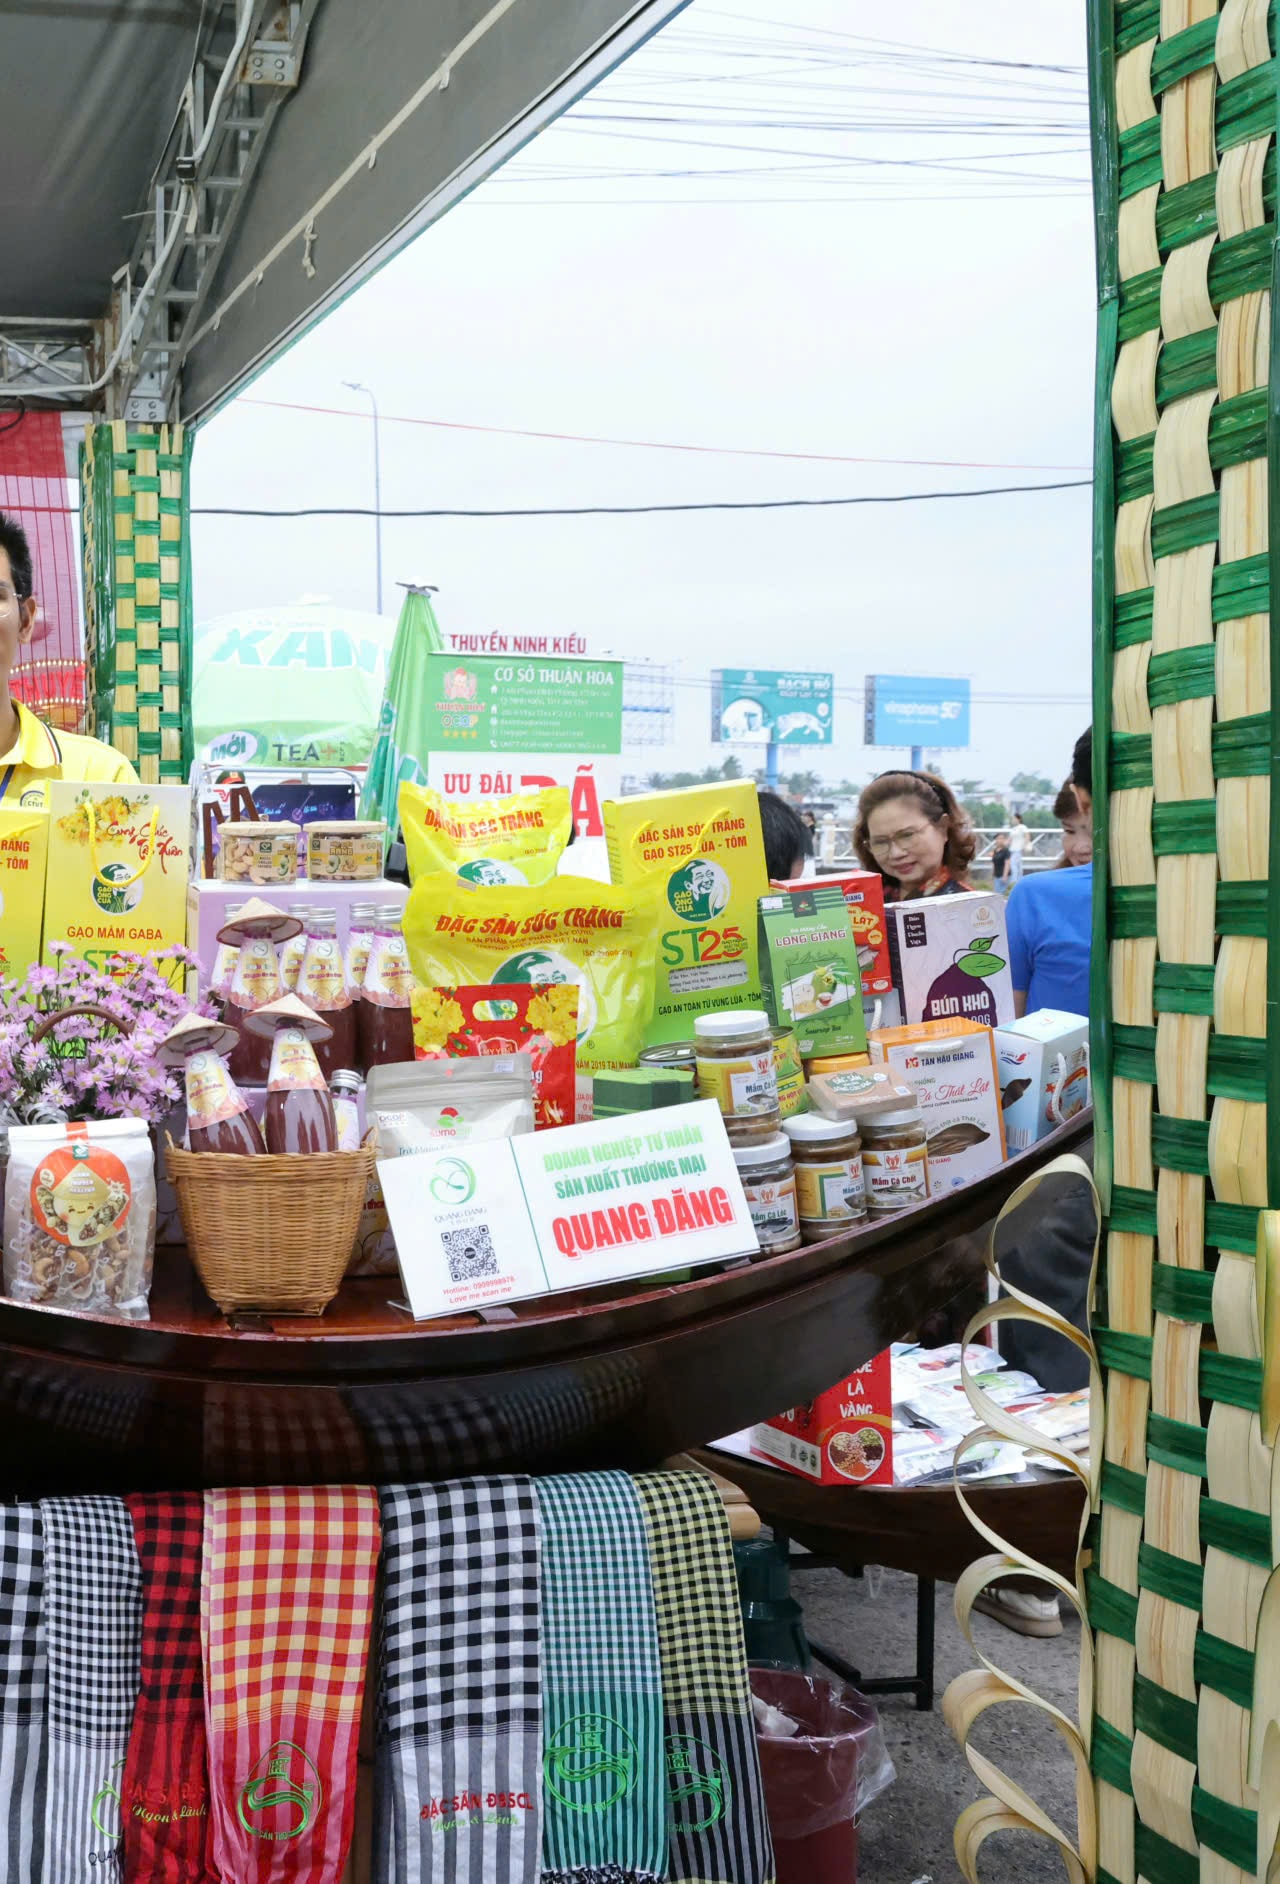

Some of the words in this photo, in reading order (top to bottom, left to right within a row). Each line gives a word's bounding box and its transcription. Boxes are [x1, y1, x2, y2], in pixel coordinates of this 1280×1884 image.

[444, 773, 471, 793] ƯU
[644, 849, 664, 862] GẠO
[668, 844, 693, 858] ST25
[725, 835, 748, 849] TÔM
[7, 856, 29, 870] TÔM
[435, 914, 479, 938] ĐẶC
[480, 913, 521, 937] SẢN
[521, 909, 562, 935] SÓC
[563, 905, 625, 928] TRĂNG
[67, 926, 93, 941] GẠO
[129, 928, 163, 940] GABA
[776, 935, 807, 946] LONG
[811, 929, 846, 942] GIANG
[662, 926, 744, 966] ST25
[962, 990, 990, 1012] KHÔ
[952, 1051, 975, 1062] GIANG
[543, 1145, 590, 1173] DOANH
[591, 1138, 644, 1166] NGHIỆP
[668, 1123, 703, 1148] NHÂN
[554, 1173, 584, 1200] SẢN
[586, 1165, 621, 1196] XUẤT
[622, 1159, 678, 1188] THƯƠNG
[679, 1153, 707, 1177] MẠI
[553, 1200, 653, 1260] QUANG
[654, 1187, 734, 1235] ĐĂNG
[848, 1378, 864, 1396] LÀ
[486, 1792, 534, 1810] ĐBSCL
